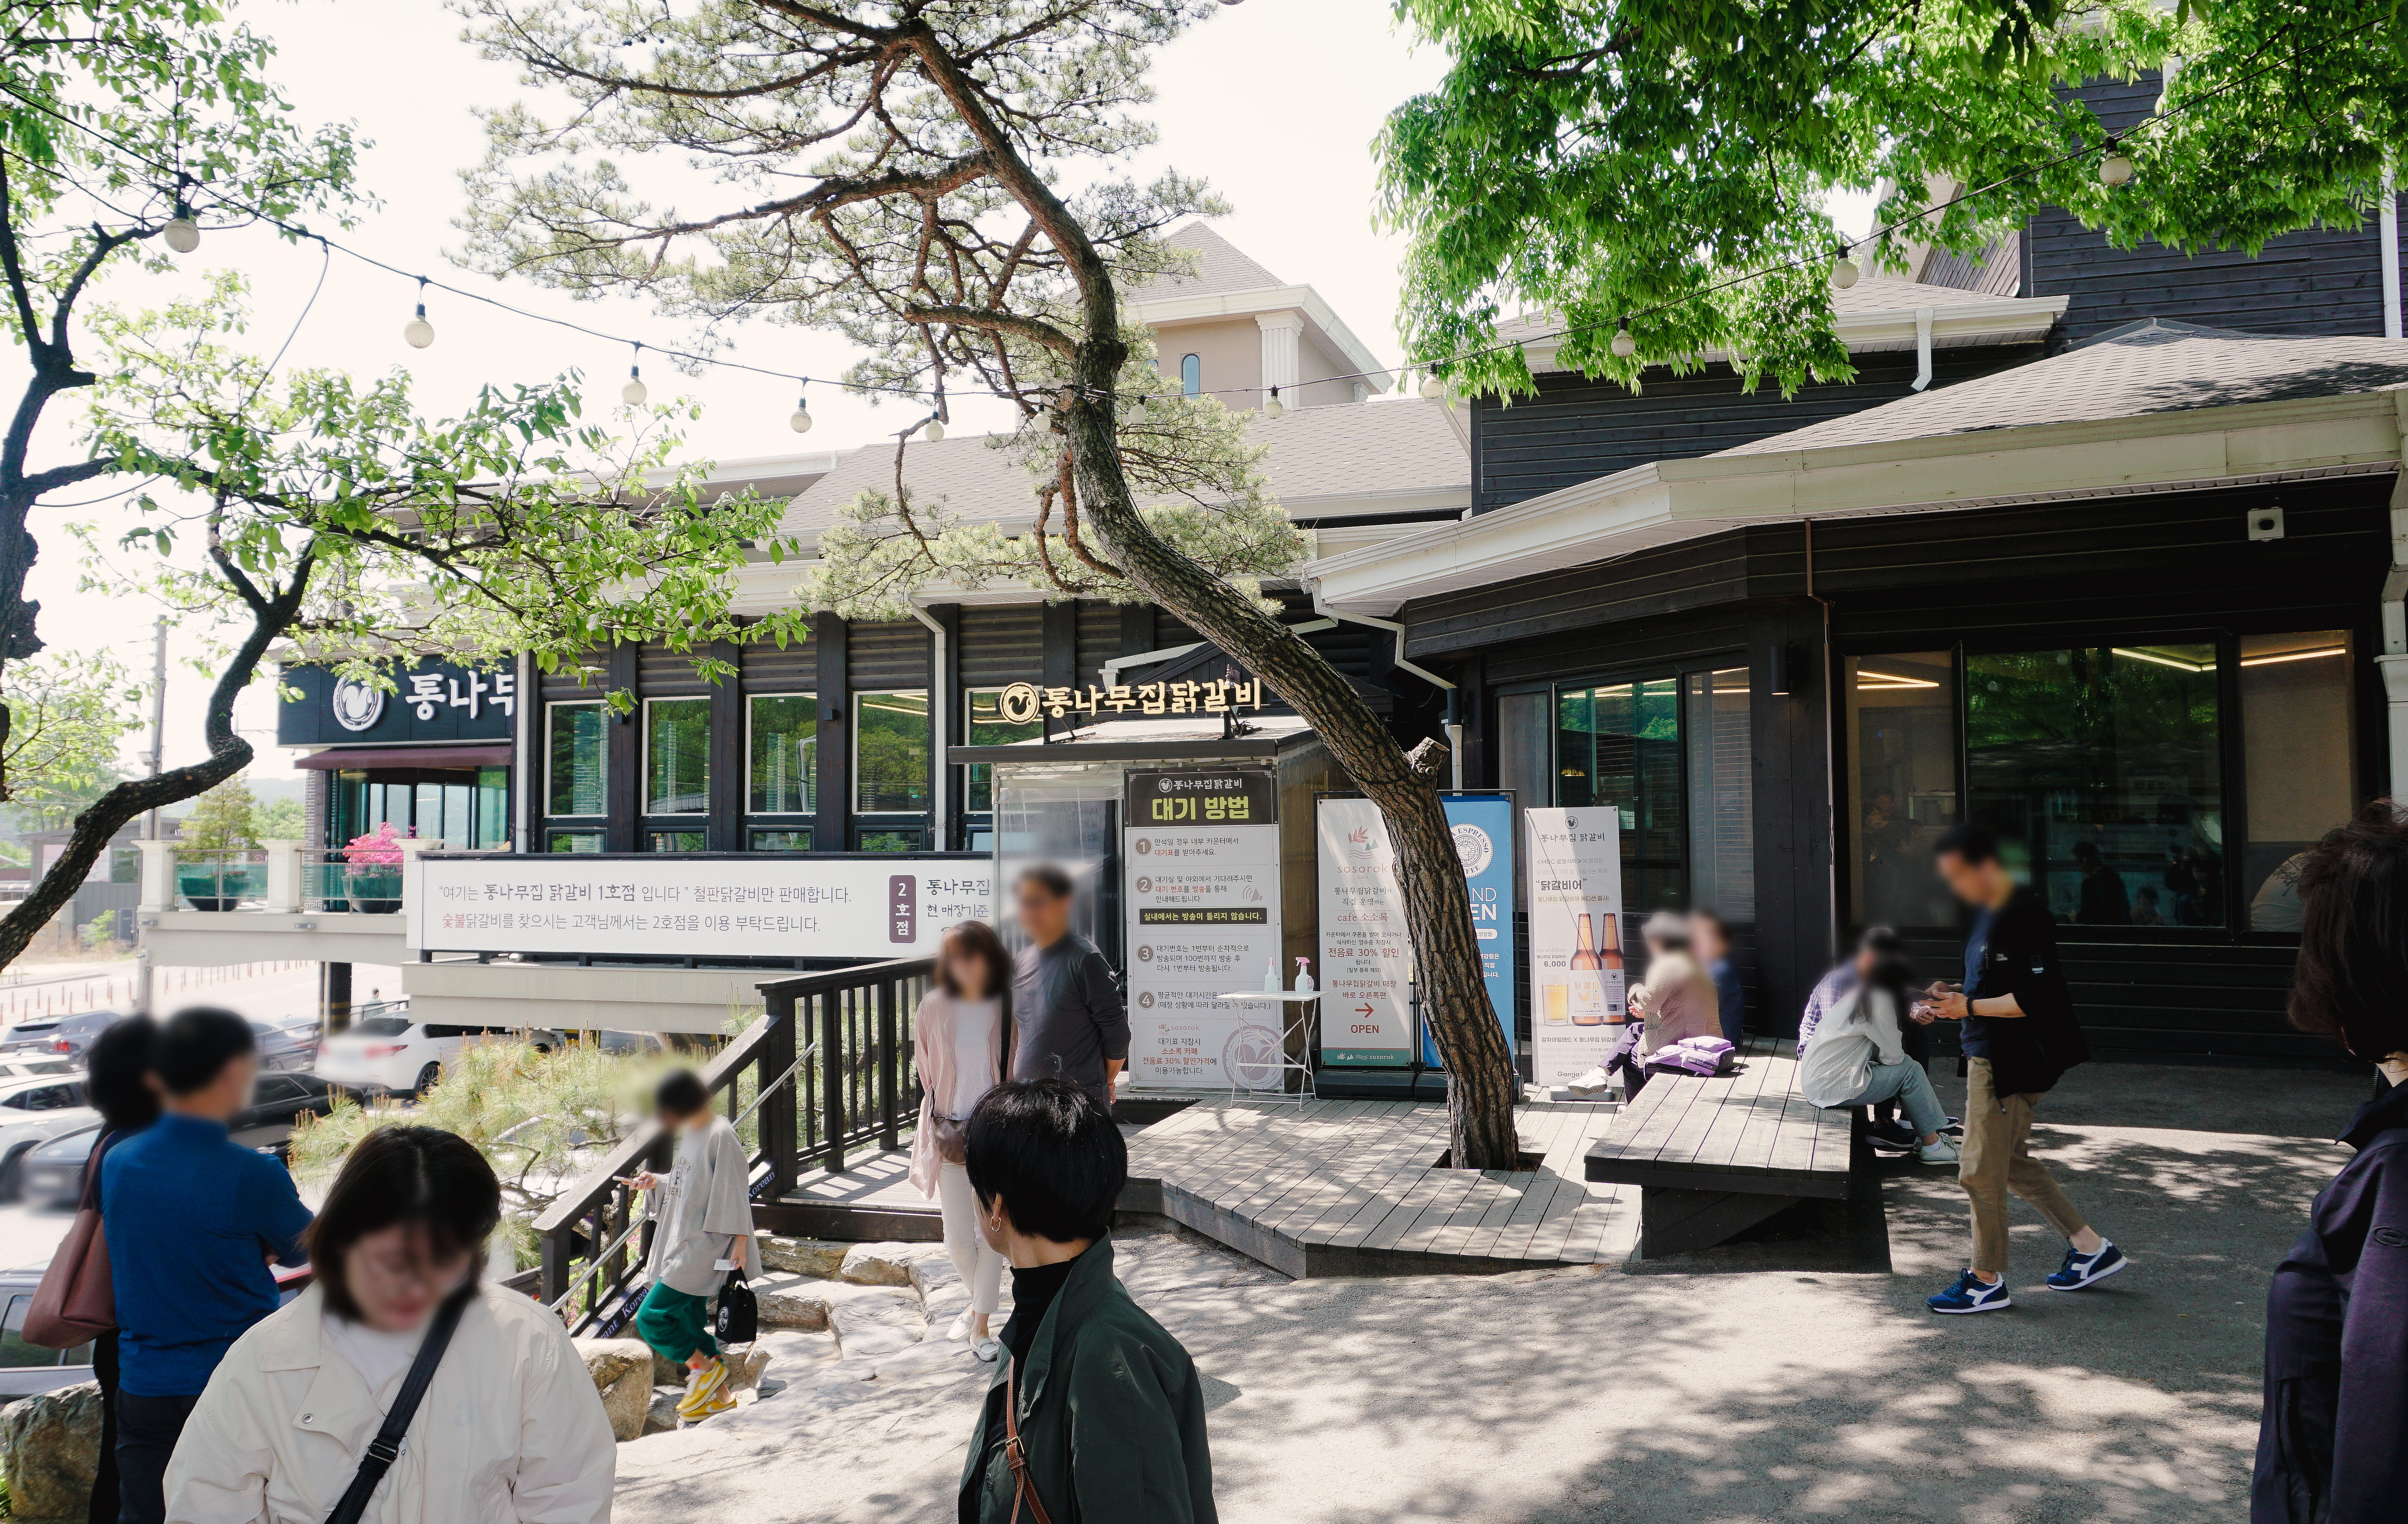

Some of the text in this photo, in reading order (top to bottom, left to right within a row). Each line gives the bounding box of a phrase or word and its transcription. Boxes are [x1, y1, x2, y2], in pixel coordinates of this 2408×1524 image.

[1042, 678, 1261, 718] 통나무집닭갈비
[1174, 778, 1241, 790] 통나무집닭갈비
[1152, 796, 1249, 820] 대기 방법
[1457, 828, 1489, 853] ESPRESSO
[1541, 833, 1604, 842] 통나무집 닭갈비
[1139, 841, 1146, 852] 1
[1337, 863, 1388, 873] sosorok
[927, 879, 989, 895] 통나무집
[1139, 879, 1148, 890] 2
[483, 884, 542, 900] 통나무집
[549, 883, 590, 901] 닭갈비
[598, 884, 635, 901] 1호점
[694, 886, 774, 903] 철판닭갈비만
[779, 887, 851, 903] 판매합니다.
[896, 882, 909, 936] 2호점
[927, 904, 988, 917] 현 매장기준
[1471, 904, 1496, 920] EN
[442, 913, 820, 932] 숯불닭갈비를 찾으시는 고객님께서는 2호점을 이용 부탁드립니다.
[1144, 912, 1262, 921] 실내에서는 방송이 들리지 않습니다.
[1360, 913, 1388, 922] 소소록
[1142, 948, 1149, 960] 3
[1329, 948, 1354, 957] 전음료
[1382, 948, 1399, 958] 할인
[1142, 994, 1150, 1006] 4
[1186, 991, 1217, 999] 대기시간은
